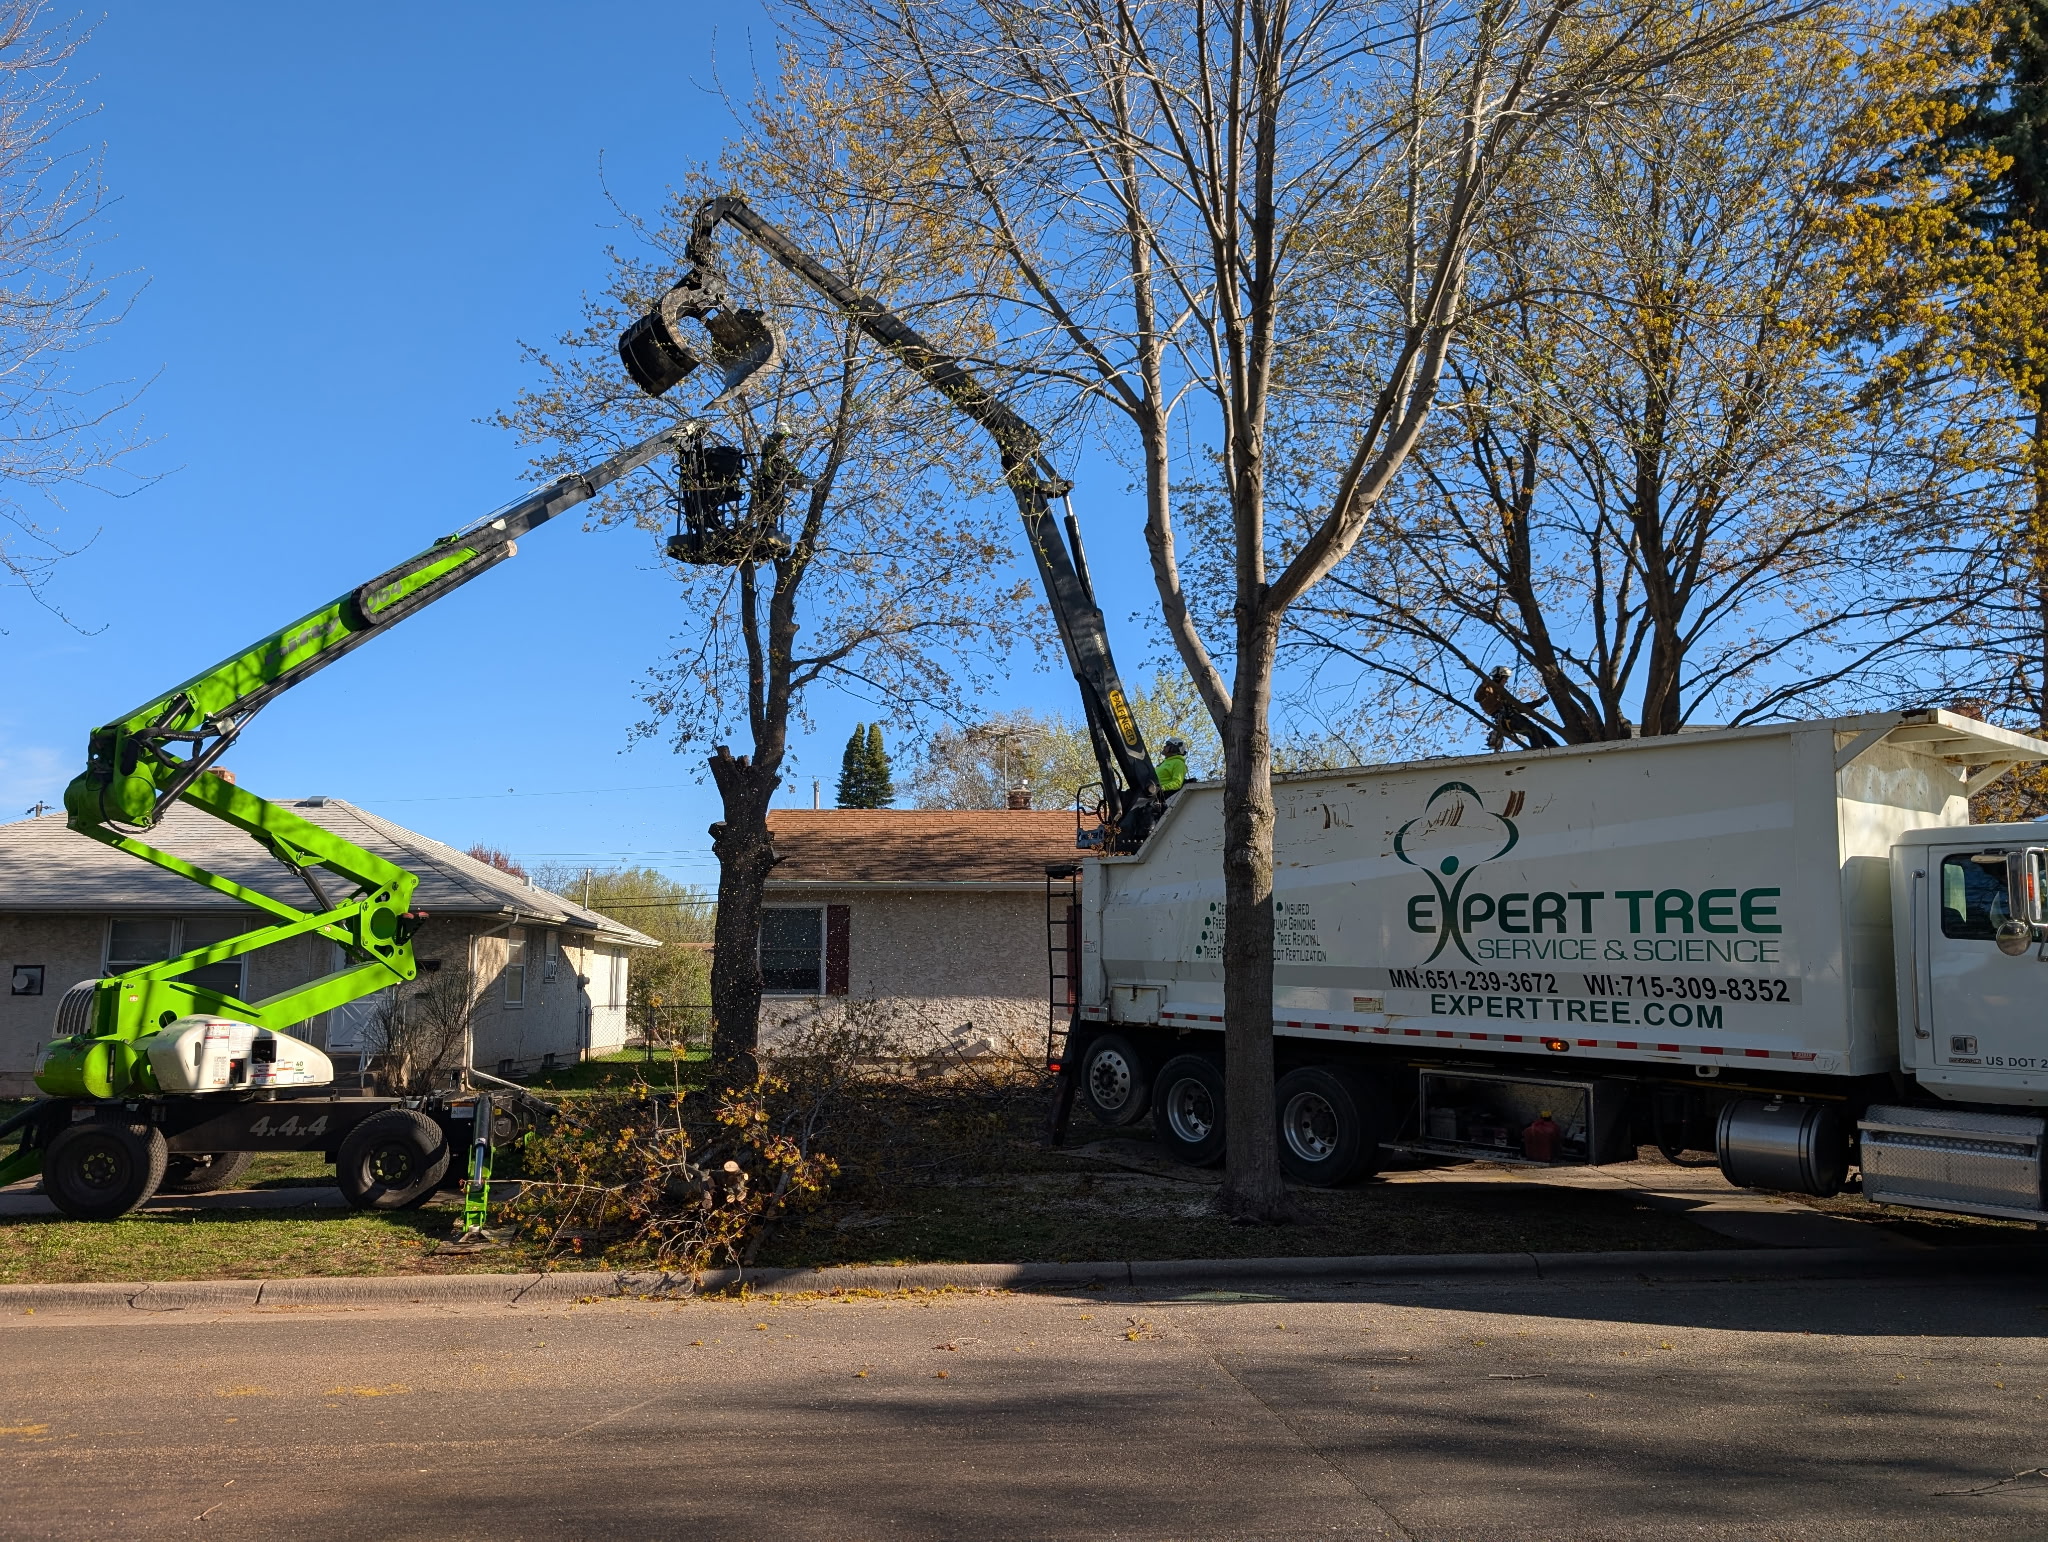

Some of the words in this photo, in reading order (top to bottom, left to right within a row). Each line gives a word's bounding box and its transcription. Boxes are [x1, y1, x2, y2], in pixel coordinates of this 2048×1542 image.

[265, 615, 341, 665] nifty
[1112, 692, 1136, 743] PALFINGER
[1284, 902, 1310, 915] INSURED
[1615, 887, 1783, 934] TREE
[1212, 916, 1225, 930] FREE
[1275, 918, 1288, 931] UMP
[1288, 916, 1316, 931] GRINDING
[1277, 931, 1292, 946] TREE
[1292, 931, 1321, 947] REMOVAL
[1203, 945, 1217, 959] TREE
[1273, 949, 1285, 961] OOT
[1285, 947, 1327, 962] FERTILIZATION
[1477, 938, 1598, 961] SERVICE
[1603, 939, 1629, 961] &
[1633, 939, 1780, 963] SCIENCE
[1388, 968, 1559, 994] MN:651-239-3672
[1582, 973, 1791, 1003] WI:715-309-8352
[1430, 993, 1723, 1030] EXPERTTREE.COM
[1985, 1056, 2004, 1066] US
[2008, 1057, 2037, 1068] DOT
